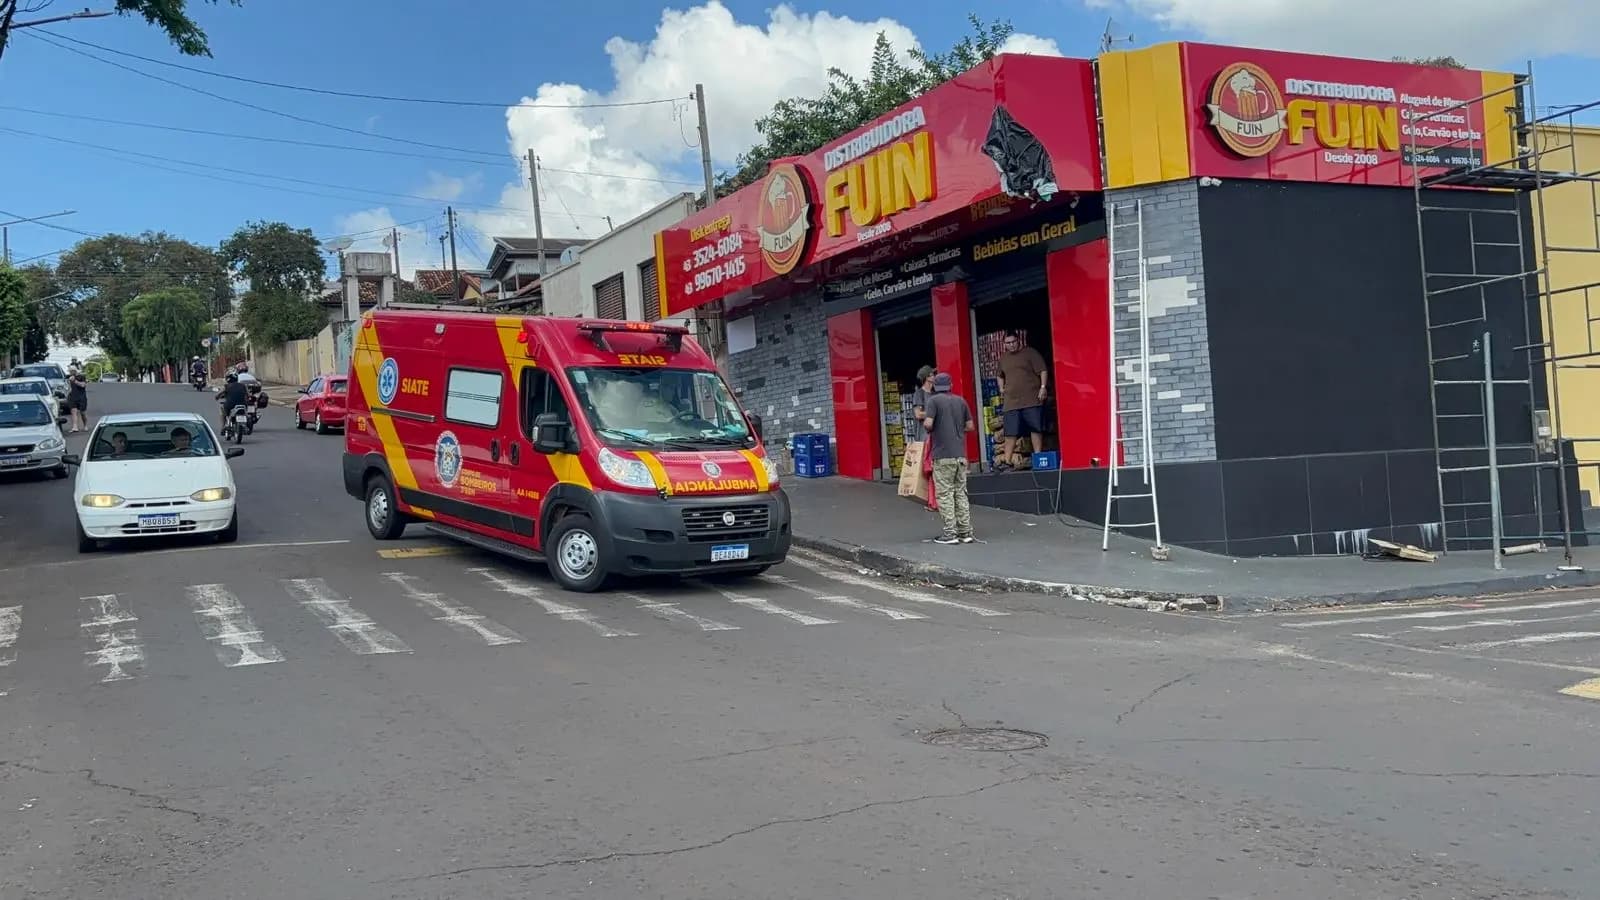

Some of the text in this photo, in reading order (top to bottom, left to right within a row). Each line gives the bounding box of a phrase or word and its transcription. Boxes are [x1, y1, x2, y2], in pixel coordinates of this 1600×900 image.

[1285, 79, 1396, 102] DISTRIBUIDORA
[1400, 93, 1431, 107] Aluguel
[1432, 95, 1443, 106] de
[1236, 121, 1264, 136] FUIN
[1287, 99, 1400, 151] FUIN
[823, 106, 927, 172] DISTRIBUIDORA
[1324, 152, 1379, 165] Desde 2008
[825, 131, 934, 238] FUIN
[774, 231, 793, 251] FUIN
[857, 228, 875, 242] Desde
[973, 214, 1077, 261] Bebidas em Geral
[693, 231, 744, 268] 3524-6084
[694, 254, 747, 292] 99670-1415
[401, 377, 430, 396] SIATE
[460, 476, 497, 492] BOMBEIROS
